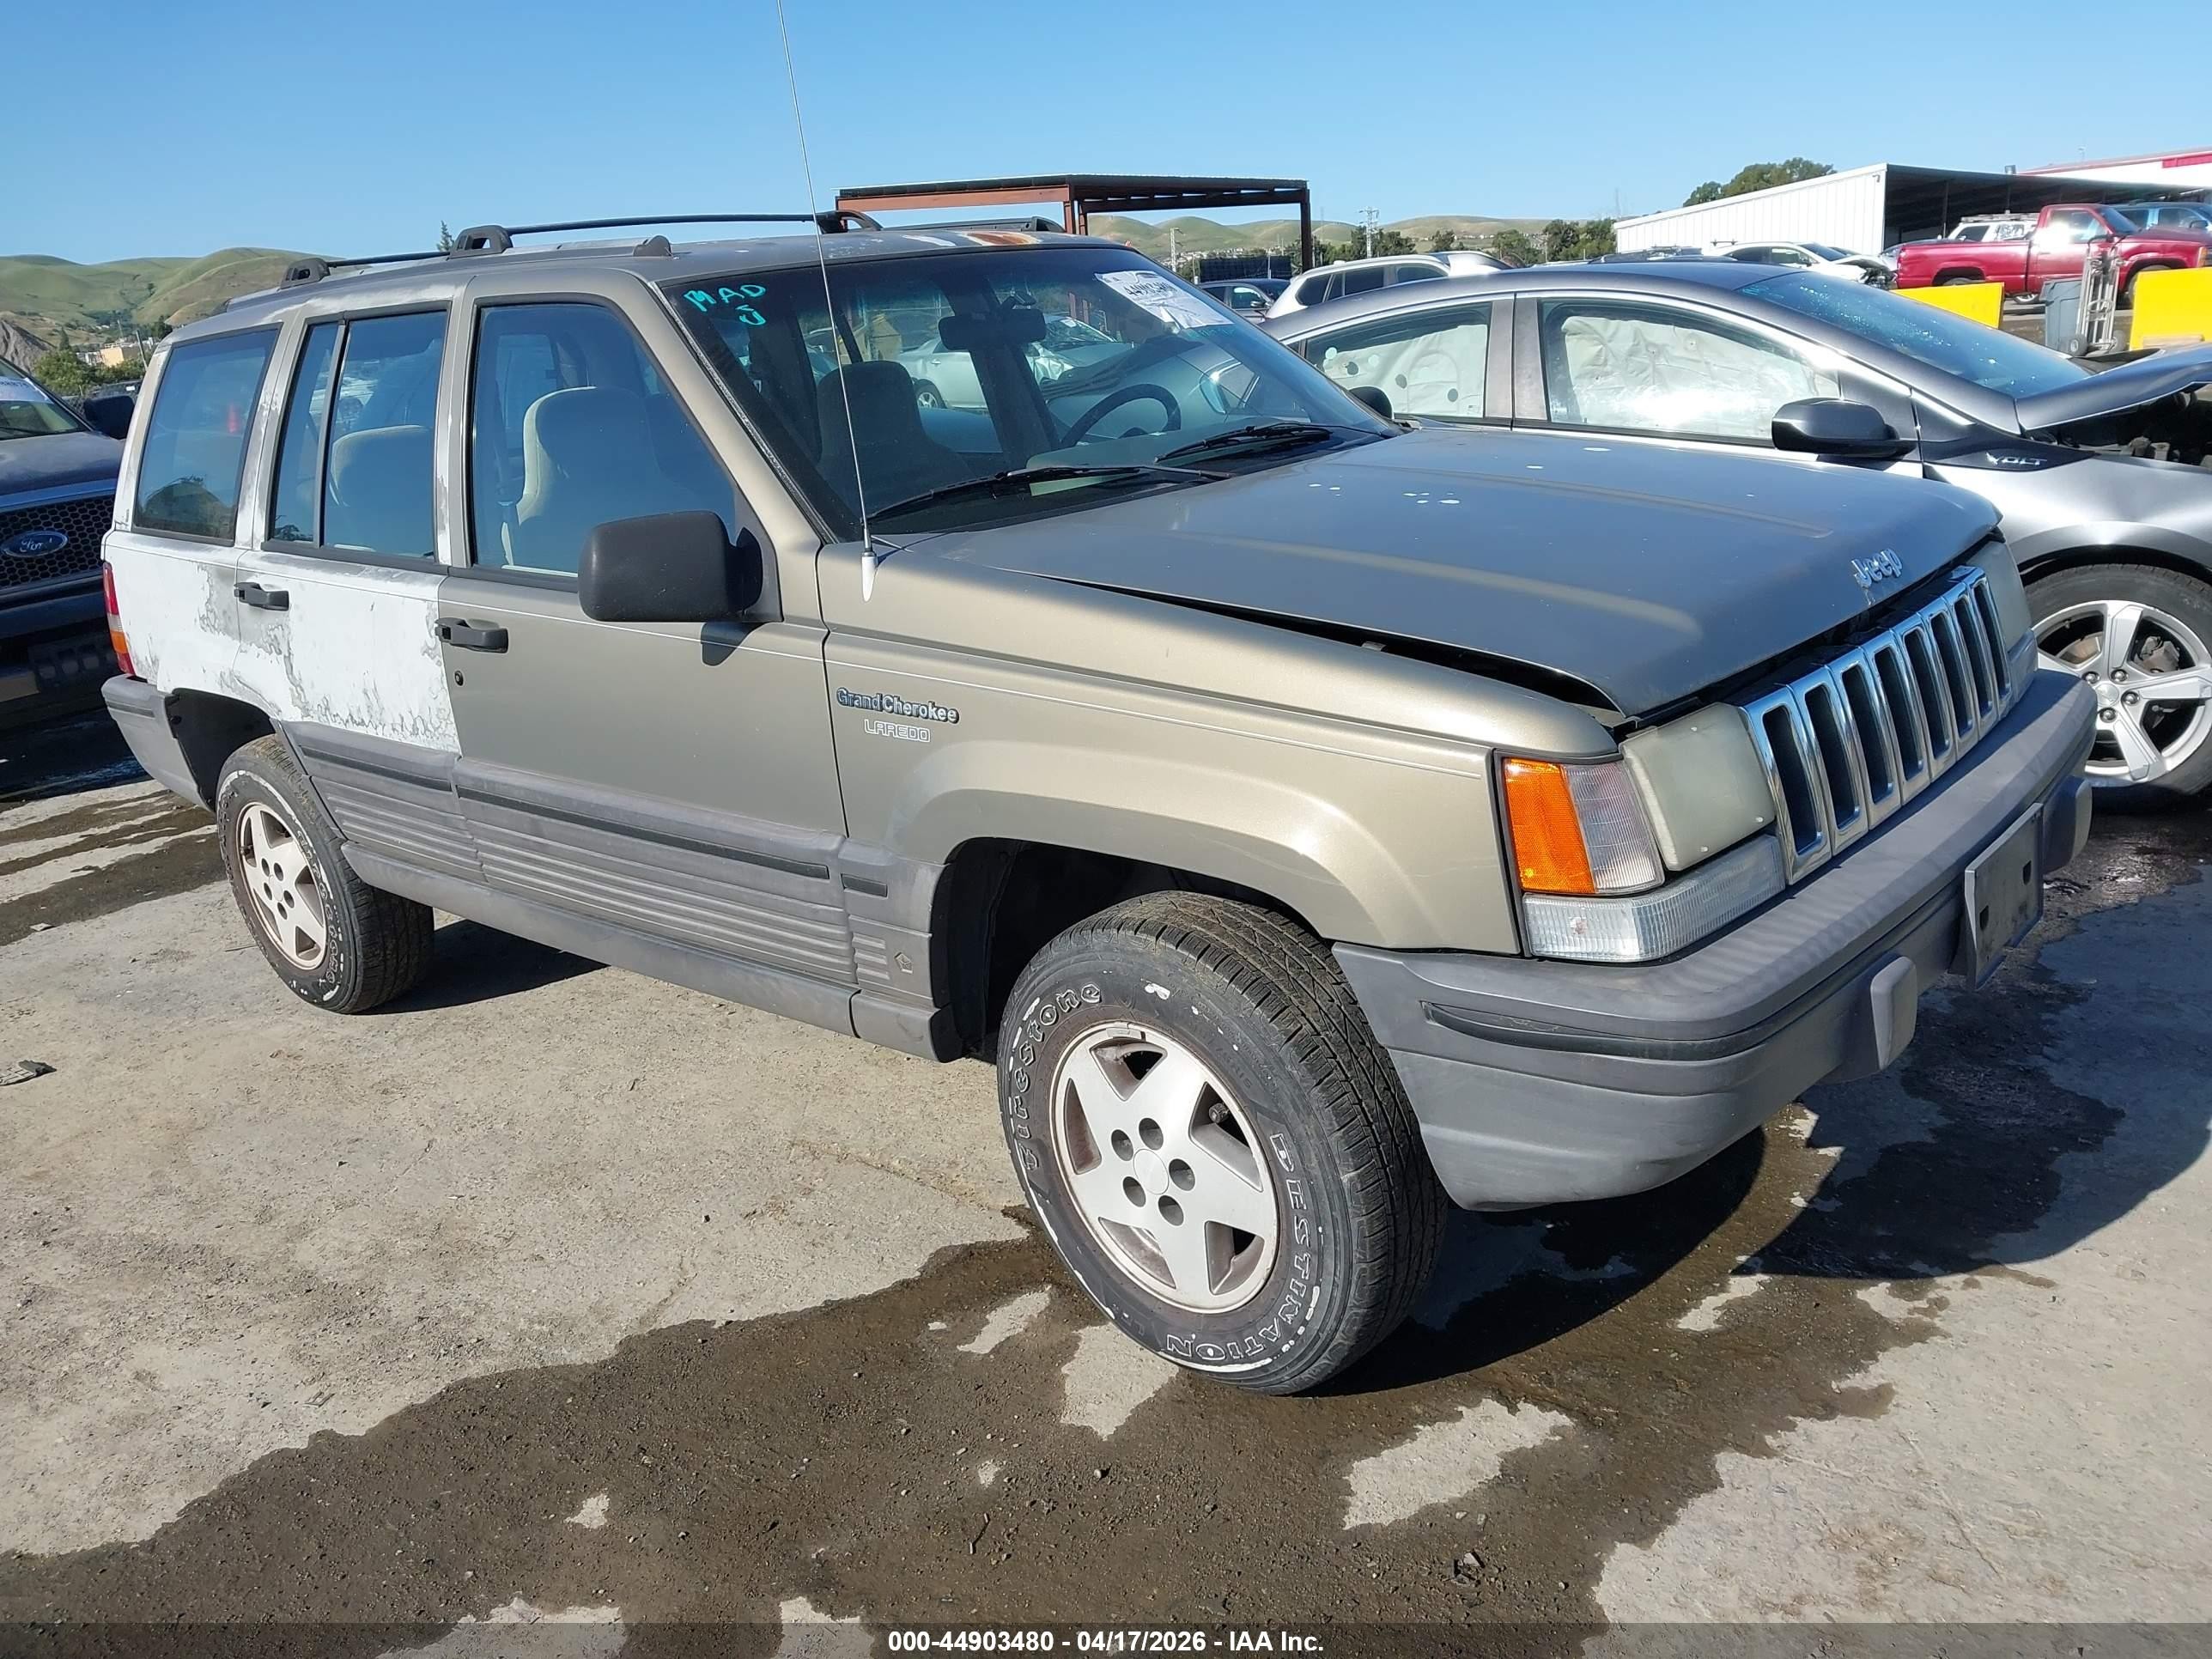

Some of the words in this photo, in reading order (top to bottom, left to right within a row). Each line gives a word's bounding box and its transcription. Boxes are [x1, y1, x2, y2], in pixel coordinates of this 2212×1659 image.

[684, 284, 766, 312] MAD
[1985, 452, 2047, 465] VOLT
[1851, 549, 1903, 588] Jeep
[836, 687, 883, 712] Grand
[881, 695, 960, 724] Cherokee
[864, 719, 931, 742] LAREDO
[1013, 983, 1102, 1171] Firestone
[1165, 1133, 1311, 1360] DESTINATION
